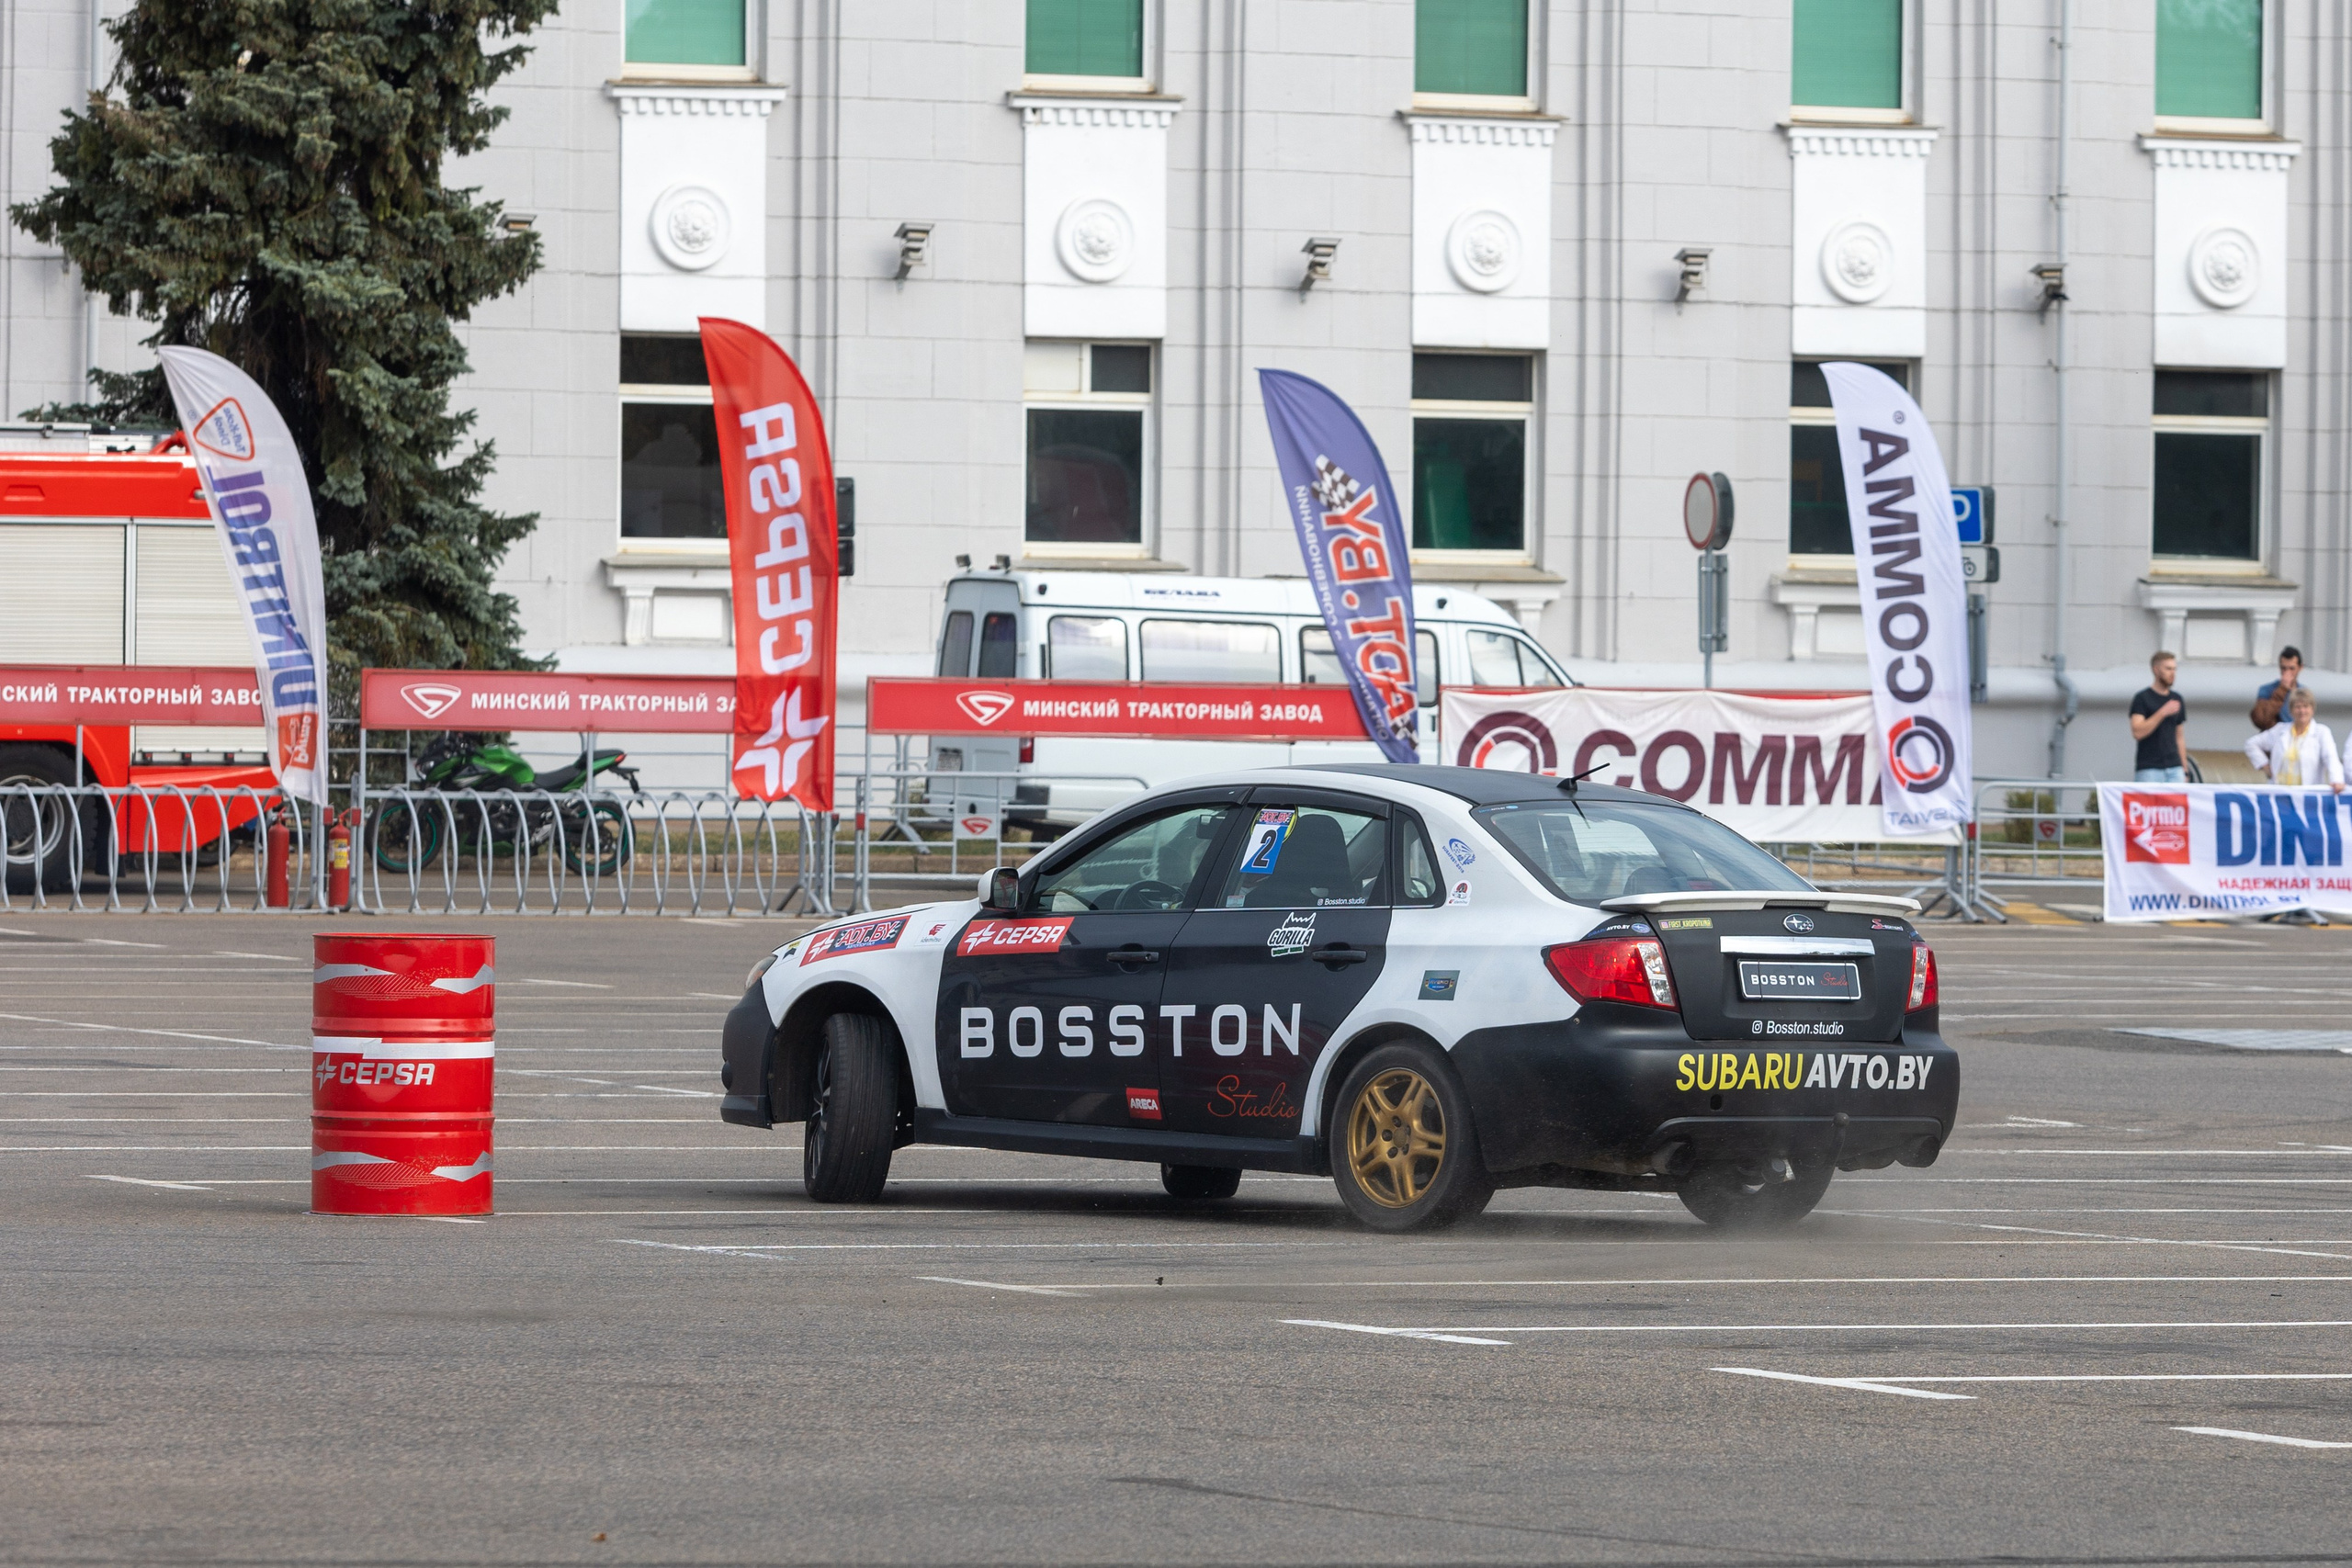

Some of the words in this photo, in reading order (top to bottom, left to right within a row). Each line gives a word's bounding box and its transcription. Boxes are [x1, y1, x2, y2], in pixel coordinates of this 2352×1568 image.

[1859, 426, 1931, 704] COMMA
[67, 684, 202, 705] ТРАКТОРНЫЙ
[471, 691, 570, 710] МИНСКИЙ
[579, 693, 708, 713] ТРАКТОРНЫЙ
[1023, 698, 1119, 717] МИНСКИЙ
[1127, 701, 1253, 720] ТРАКТОРНЫЙ
[1260, 704, 1324, 724] ЗАВОД
[1574, 729, 1883, 805] COMM
[2128, 801, 2186, 829] Pyrmo
[1251, 829, 1278, 869] 2
[2219, 876, 2312, 891] НАДЕЖНАЯ
[1324, 897, 1366, 906] Bosston.studio
[993, 925, 1066, 945] CEPSA
[1268, 929, 1314, 946] GORILLA
[1750, 974, 1815, 987] BOSSTON
[960, 1002, 1301, 1059] BOSSTON
[1766, 1020, 1845, 1036] Bosston.studio
[340, 1062, 435, 1086] CEPSA
[1130, 1098, 1159, 1111] ARECA
[1207, 1074, 1301, 1119] Studio
